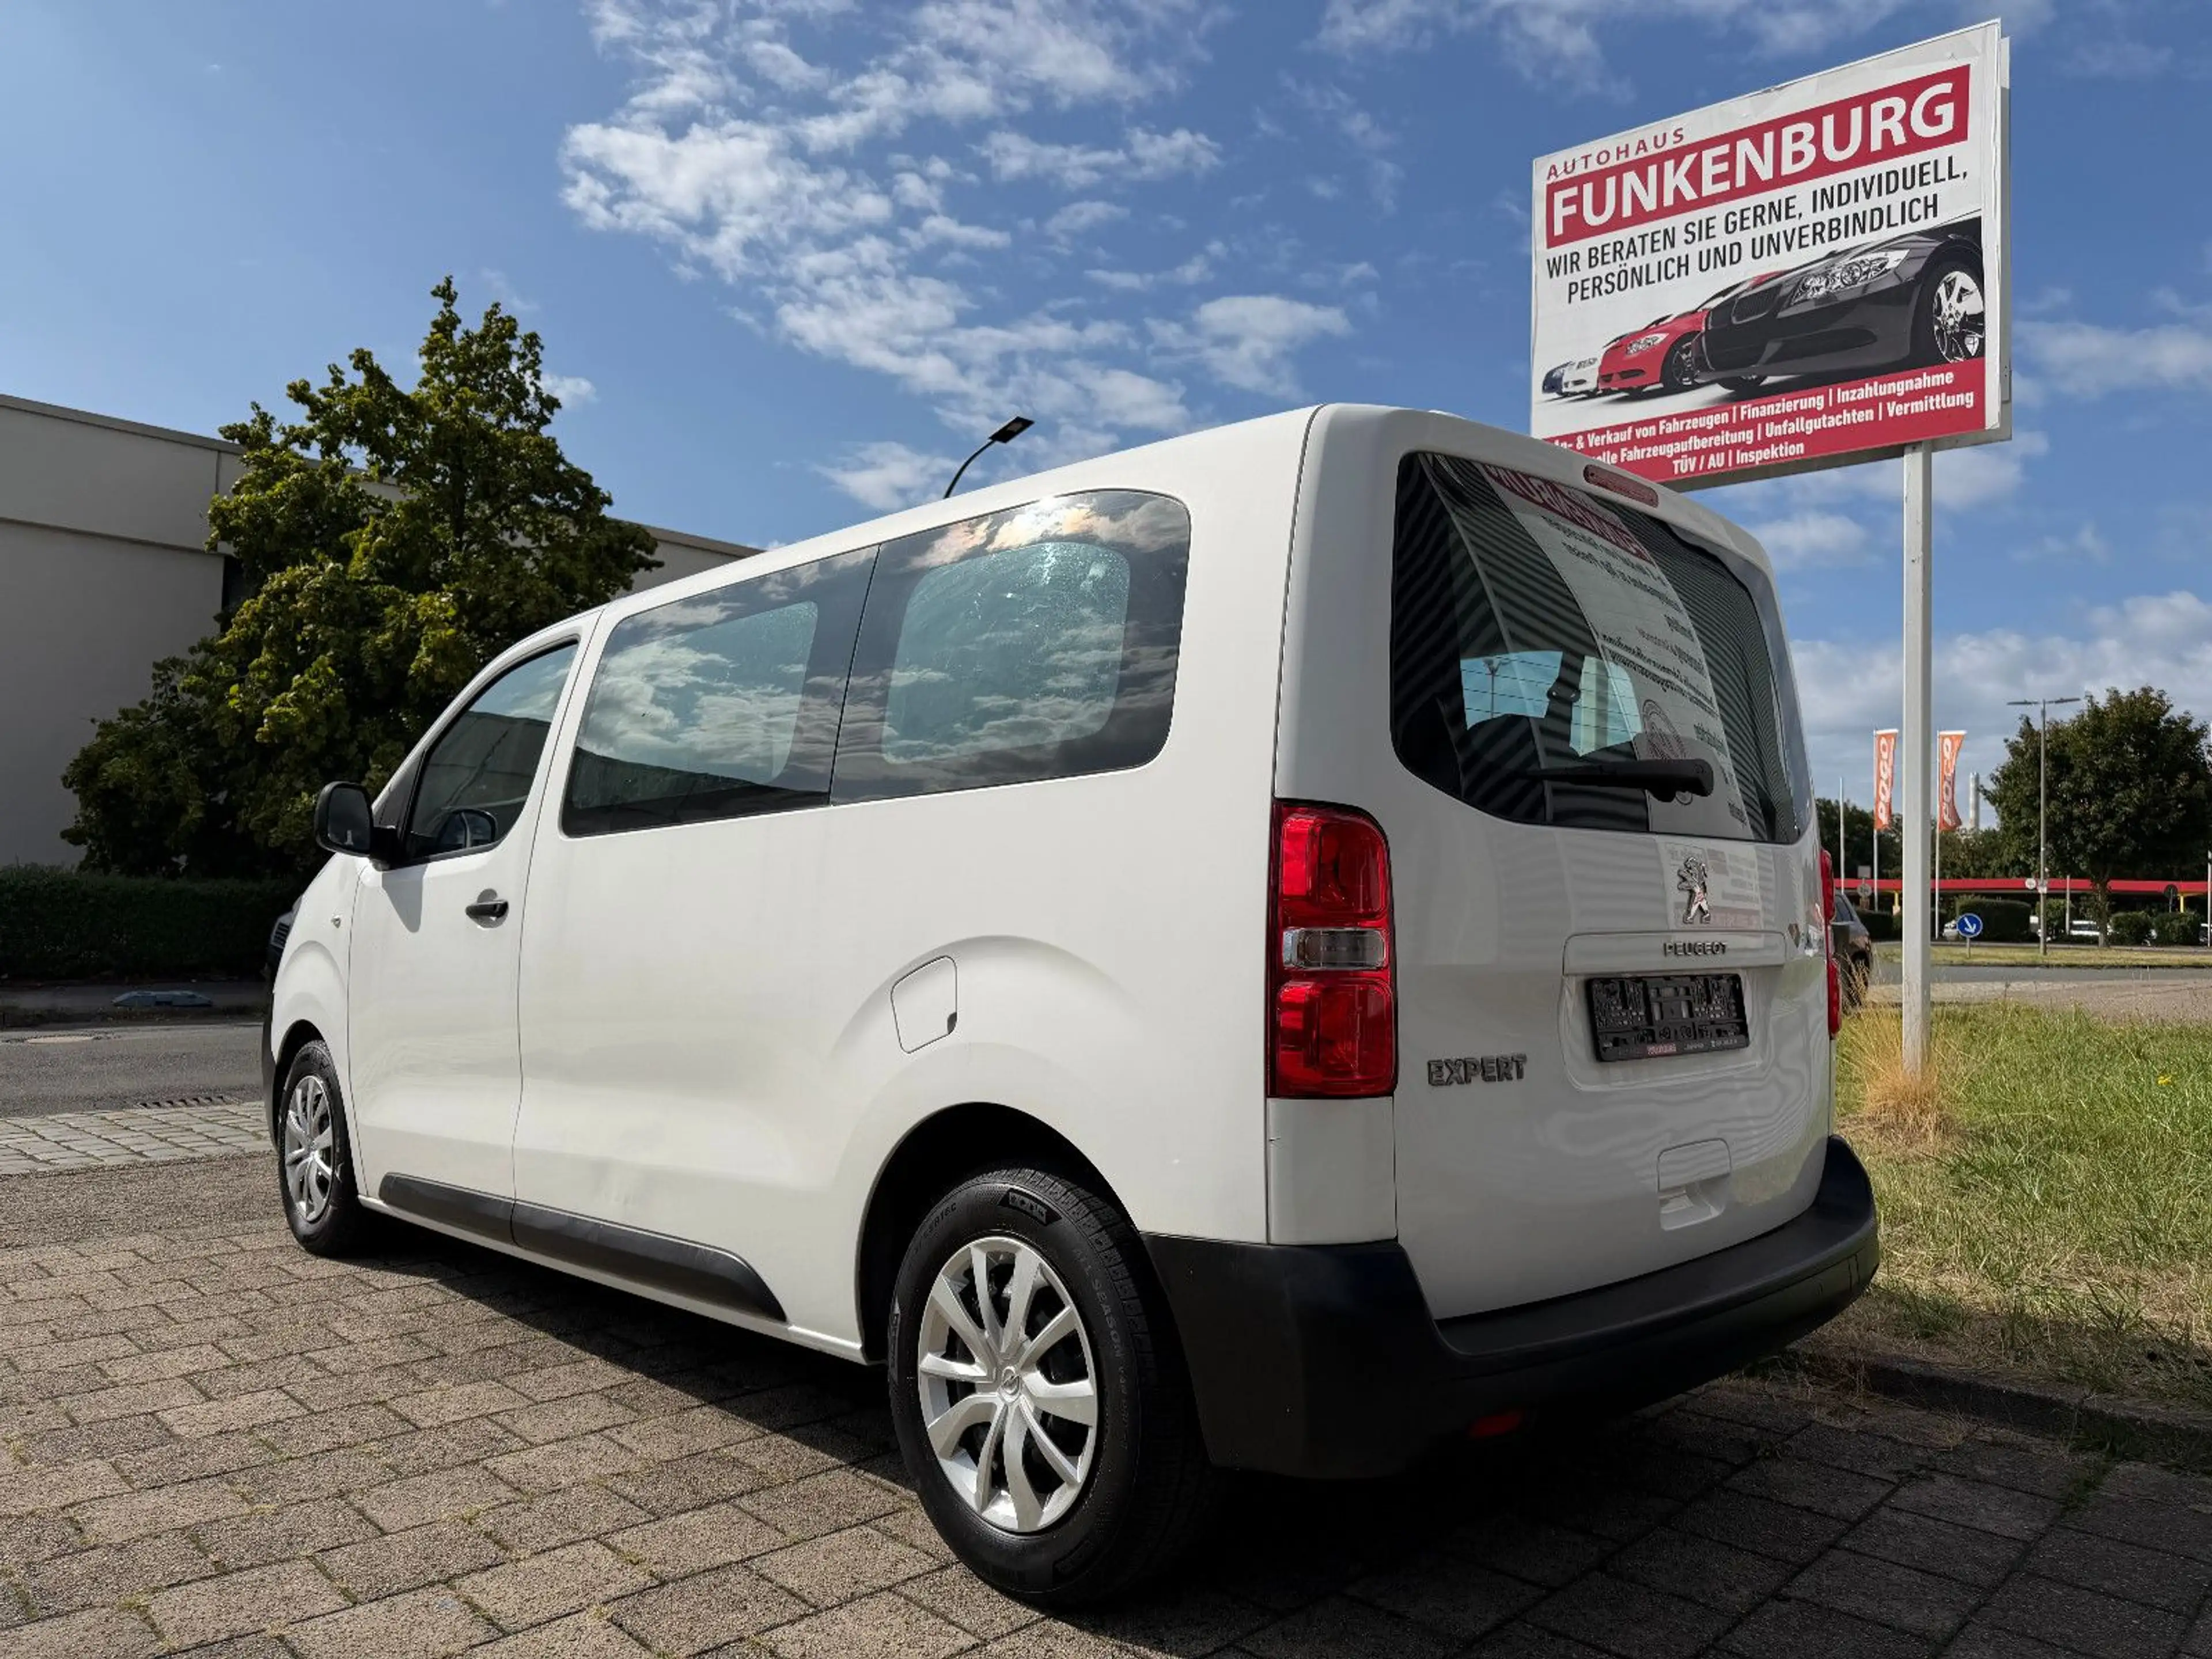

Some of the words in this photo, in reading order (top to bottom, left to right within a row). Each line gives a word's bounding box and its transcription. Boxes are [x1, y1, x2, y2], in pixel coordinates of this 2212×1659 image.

[1547, 127, 1684, 180] AUTOHAUS
[1554, 82, 1955, 237] FUNKENBURG
[1546, 251, 1581, 279] WIR
[1588, 226, 1676, 269] BERATEN
[1684, 215, 1717, 245] SIE
[1725, 195, 1802, 234] GERNE,
[1812, 155, 1968, 214] INDIVIDUELL,
[1568, 253, 1690, 304] PERSÖNLICH
[1699, 241, 1742, 272] UND
[1751, 193, 1938, 260] UNVERBINDLICH
[1576, 435, 1584, 450] &
[1587, 426, 1633, 448] Verkauf
[1635, 425, 1656, 439] von
[1659, 412, 1729, 435] Fahrzeugen
[1740, 397, 1824, 421] Finanzierung
[1837, 372, 1954, 403] Inzahlungnahme
[1620, 429, 1753, 463] Fahrzeugaufbereitung
[1766, 408, 1874, 437] Unfallgutachten
[1887, 391, 1974, 417] Vermittlung
[1673, 455, 1698, 475] TÜV
[1707, 452, 1725, 469] AU
[1736, 442, 1805, 466] Inspektion
[1663, 941, 1728, 956] PEUGEOT
[1427, 1054, 1528, 1086] EXPERT
